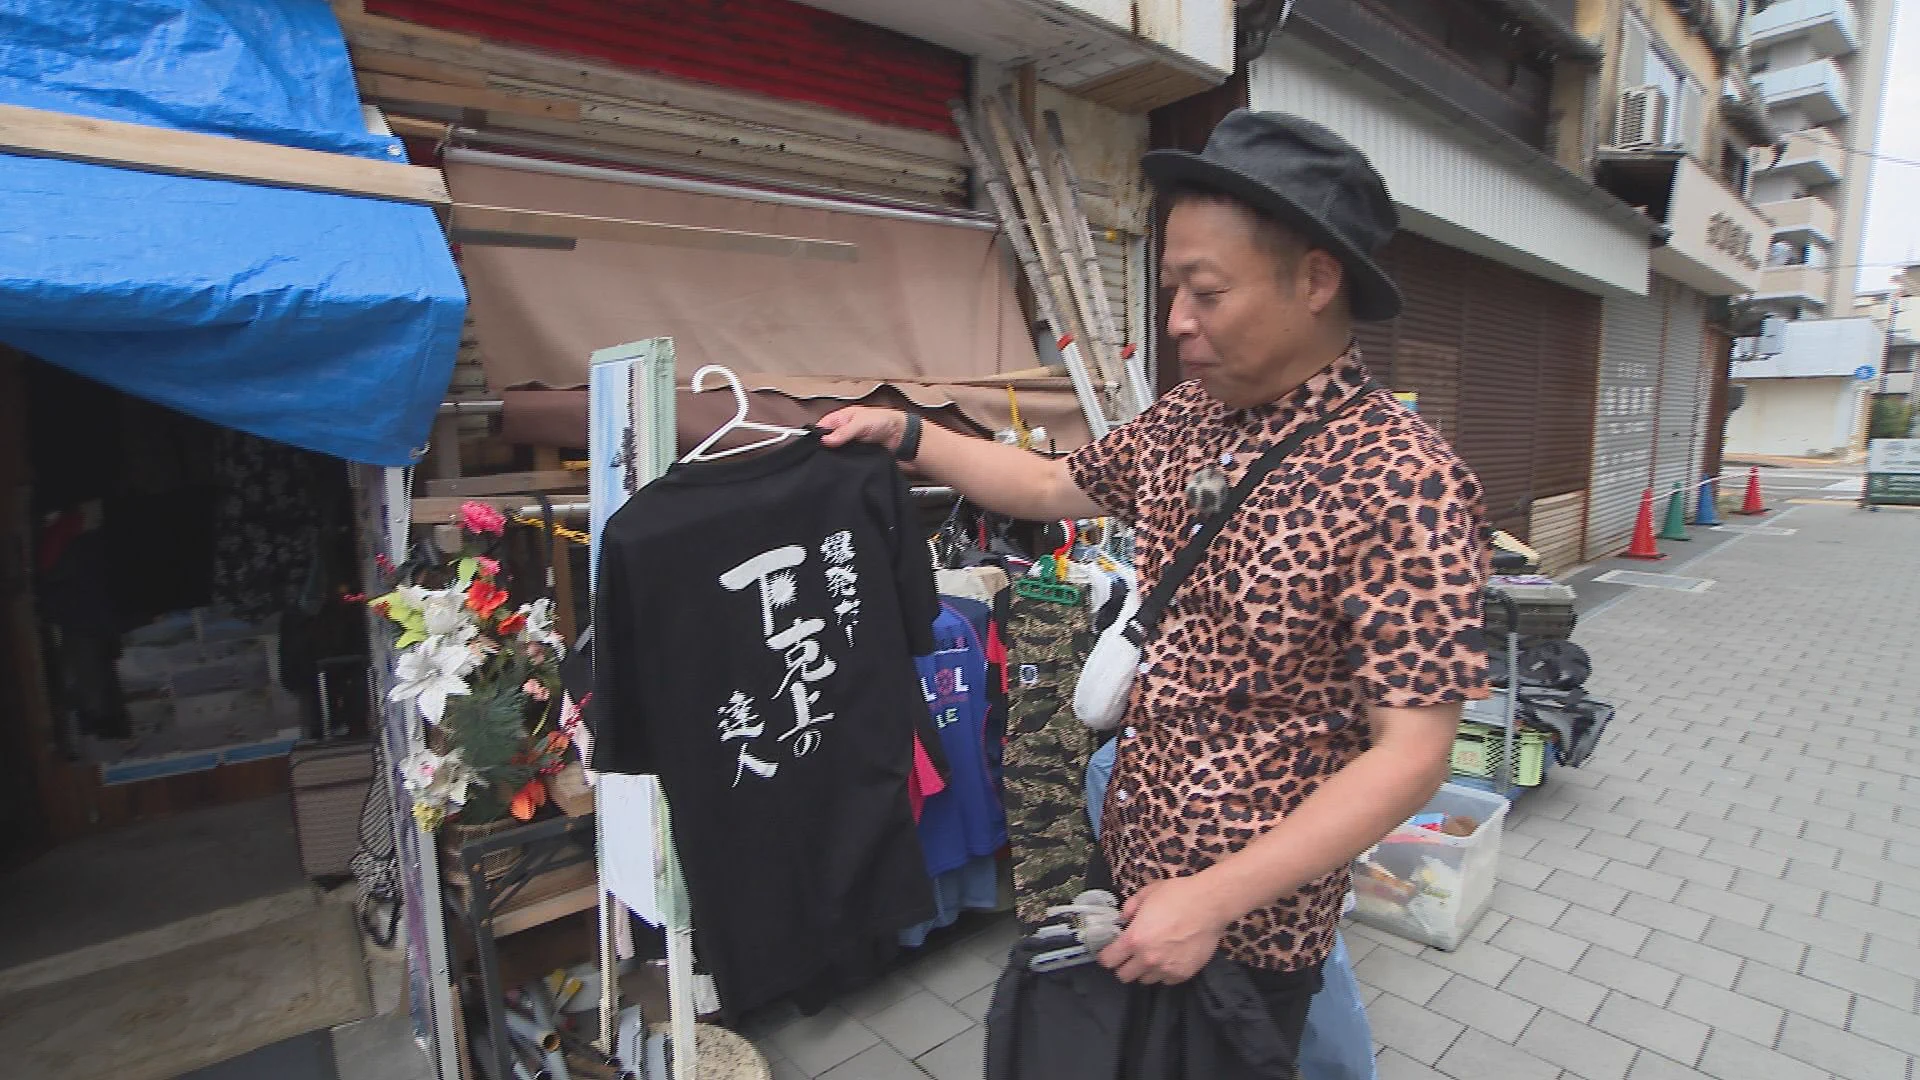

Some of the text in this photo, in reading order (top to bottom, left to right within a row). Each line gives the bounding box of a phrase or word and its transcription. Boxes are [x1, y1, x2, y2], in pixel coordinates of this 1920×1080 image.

[719, 545, 838, 757] 下克上の
[717, 690, 779, 788] 達人
